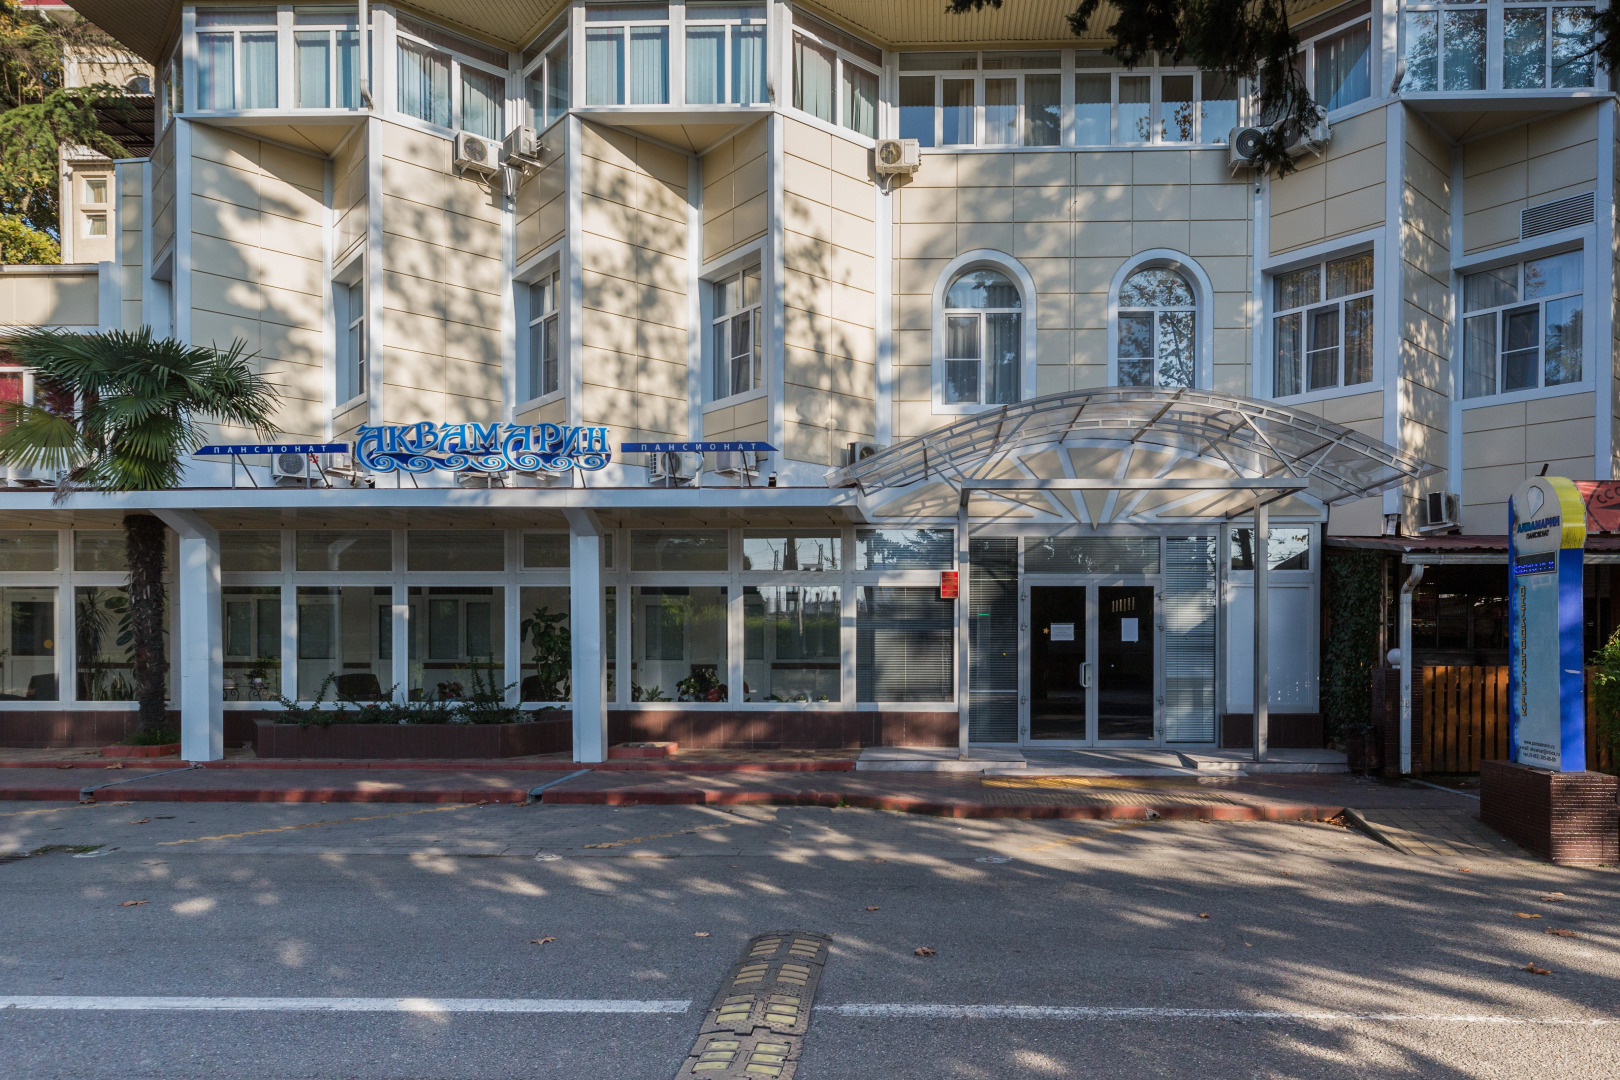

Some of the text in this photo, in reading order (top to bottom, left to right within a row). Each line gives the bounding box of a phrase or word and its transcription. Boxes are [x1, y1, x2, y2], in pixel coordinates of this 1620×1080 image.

[213, 445, 327, 454] ПАНСИОНАТ
[355, 421, 611, 473] АКВАМАРИН
[641, 442, 757, 451] ПАНСИОНАТ
[1517, 516, 1560, 533] АКВАМАРИН
